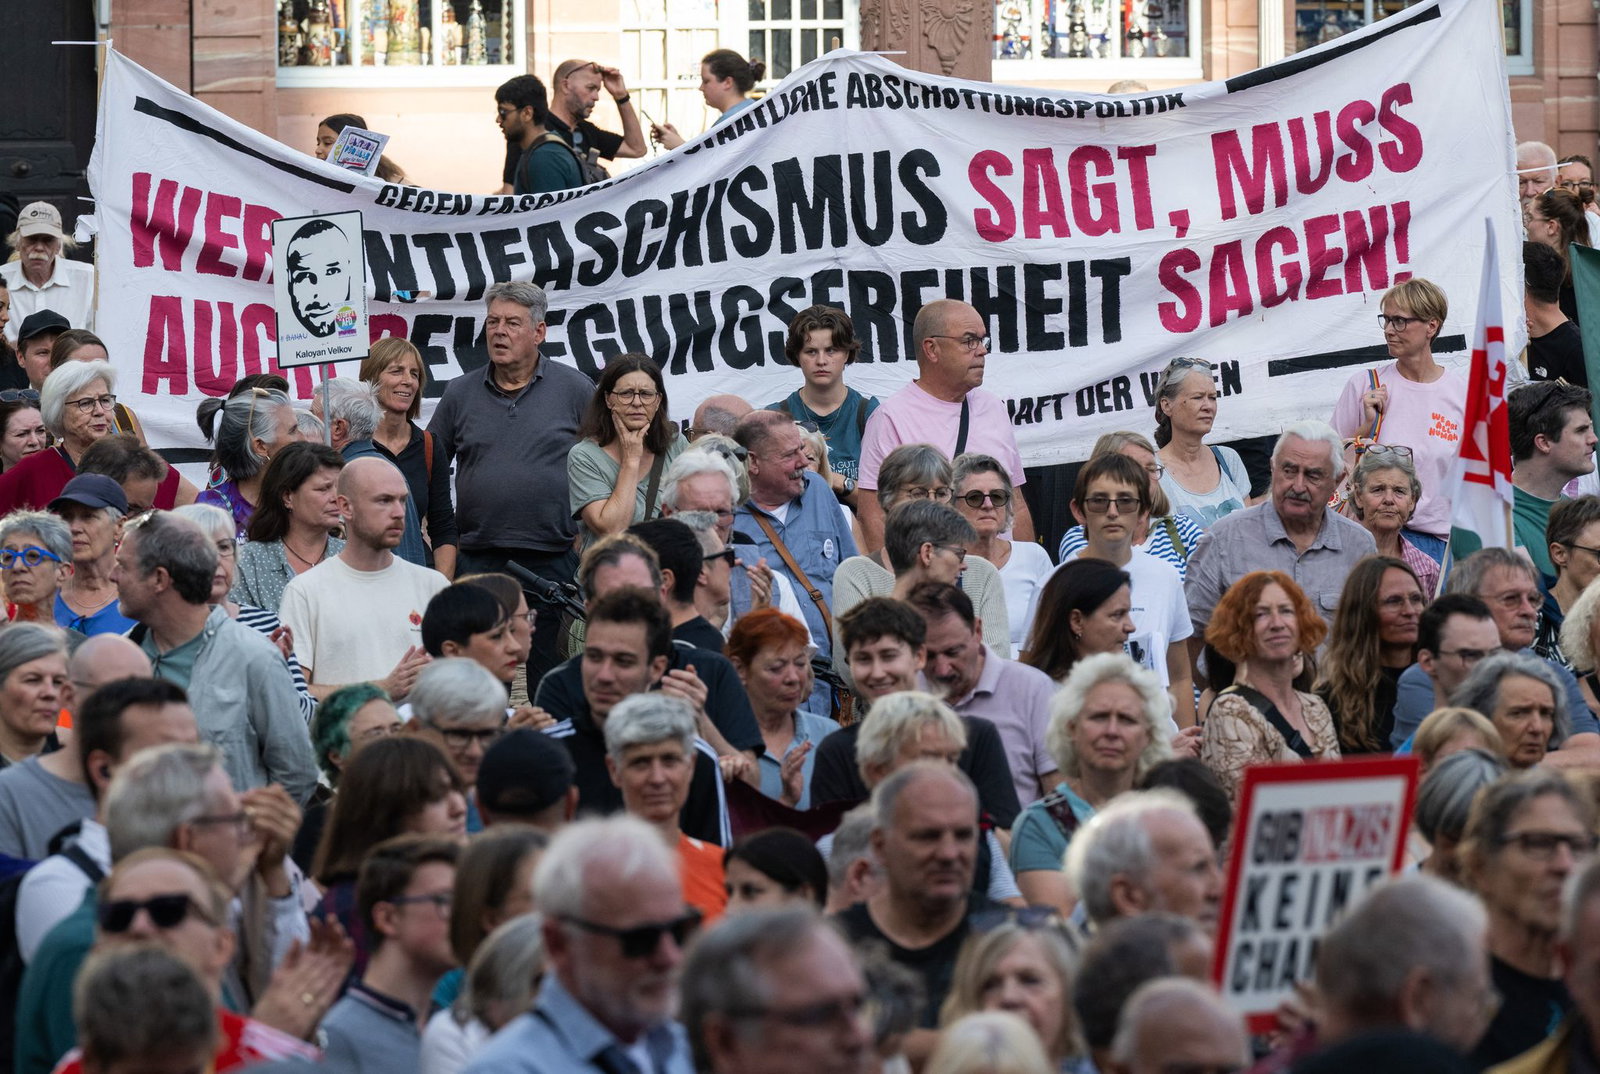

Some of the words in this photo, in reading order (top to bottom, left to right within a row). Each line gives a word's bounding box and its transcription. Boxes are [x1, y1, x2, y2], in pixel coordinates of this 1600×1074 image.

[376, 185, 472, 216] GEGEN
[847, 72, 1186, 119] ABSCHOTTUNGSPOLITIK
[364, 148, 947, 303] NTIFASCHISMUS
[968, 145, 1191, 243] SAGT,
[1211, 82, 1423, 222] MUSS
[1158, 200, 1412, 333] SAGEN!
[295, 349, 327, 359] Kaloyan
[327, 346, 353, 355] Velkov
[1075, 375, 1134, 417] DER
[1429, 427, 1458, 441] HUMAN
[1240, 867, 1384, 931] KEIN
